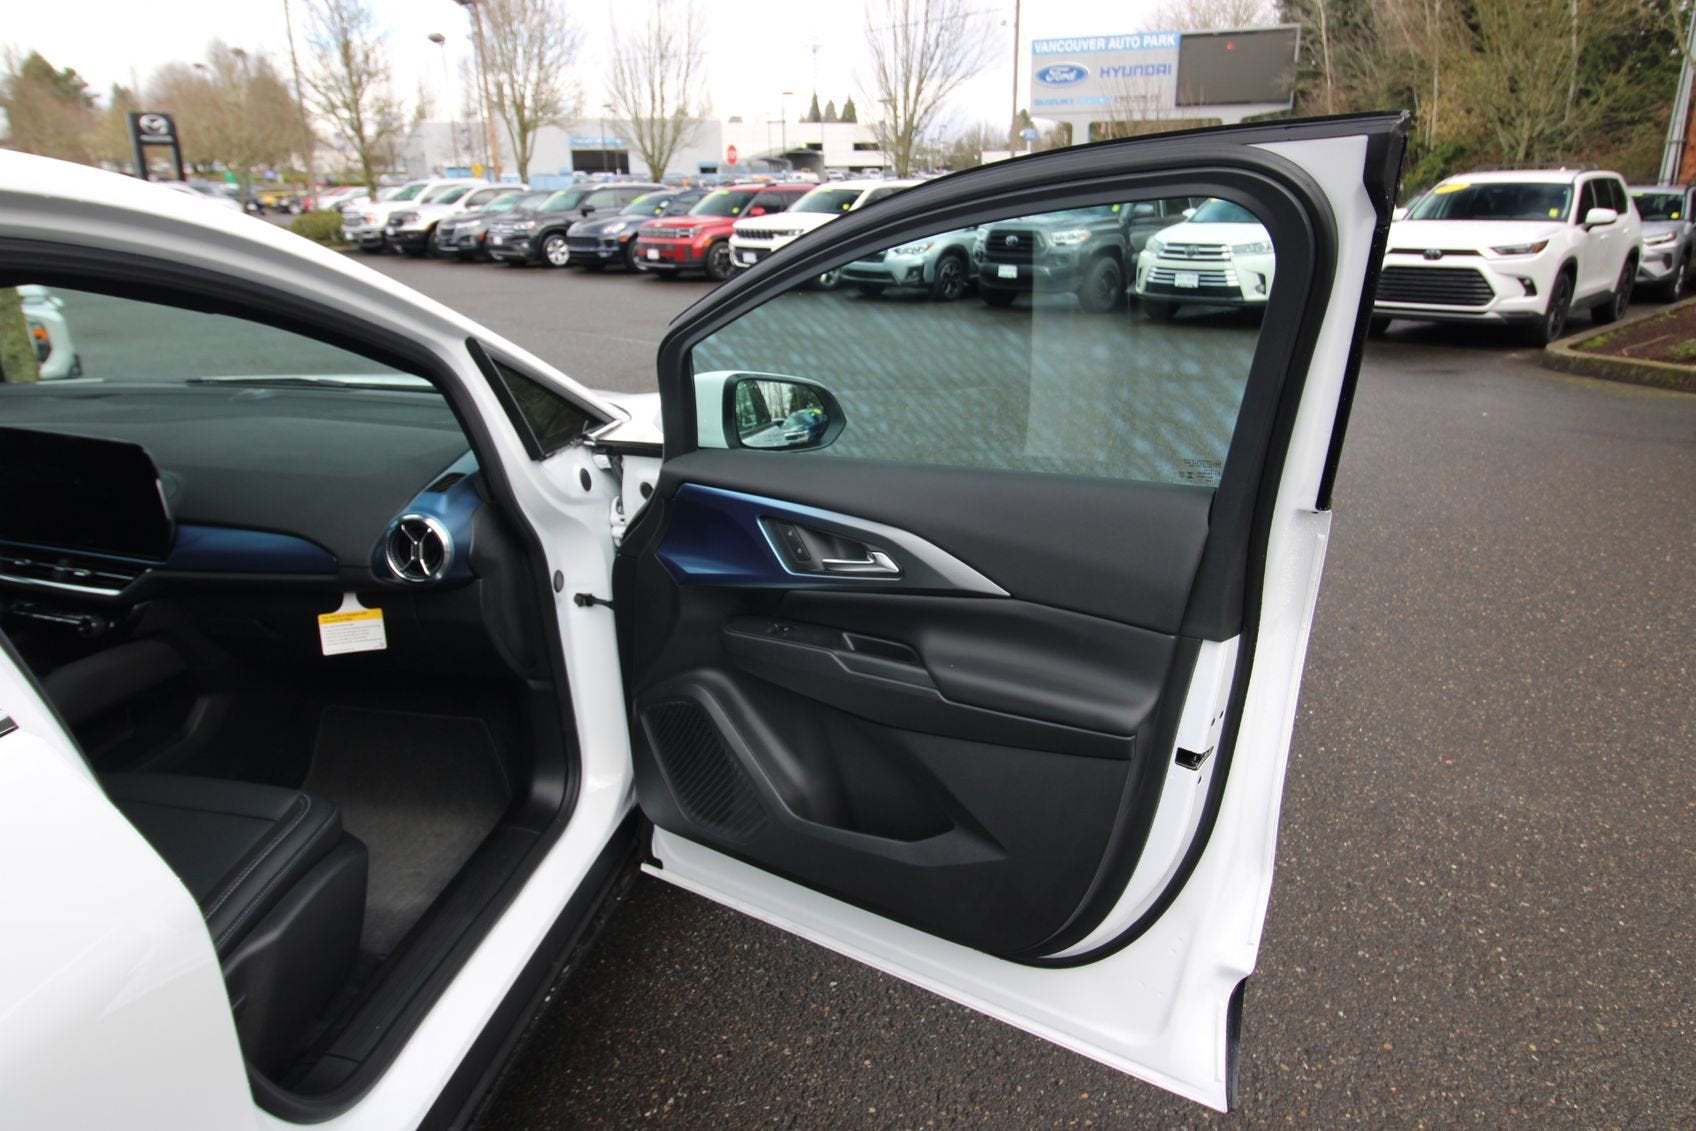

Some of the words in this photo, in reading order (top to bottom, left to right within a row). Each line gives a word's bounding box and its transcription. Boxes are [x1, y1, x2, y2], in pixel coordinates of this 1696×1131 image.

[1034, 38, 1105, 53] VANCOUVER
[1107, 36, 1140, 49] AUTO
[1143, 33, 1176, 48] PARK
[1046, 67, 1077, 82] Ford
[1100, 64, 1172, 78] HYUNDAI
